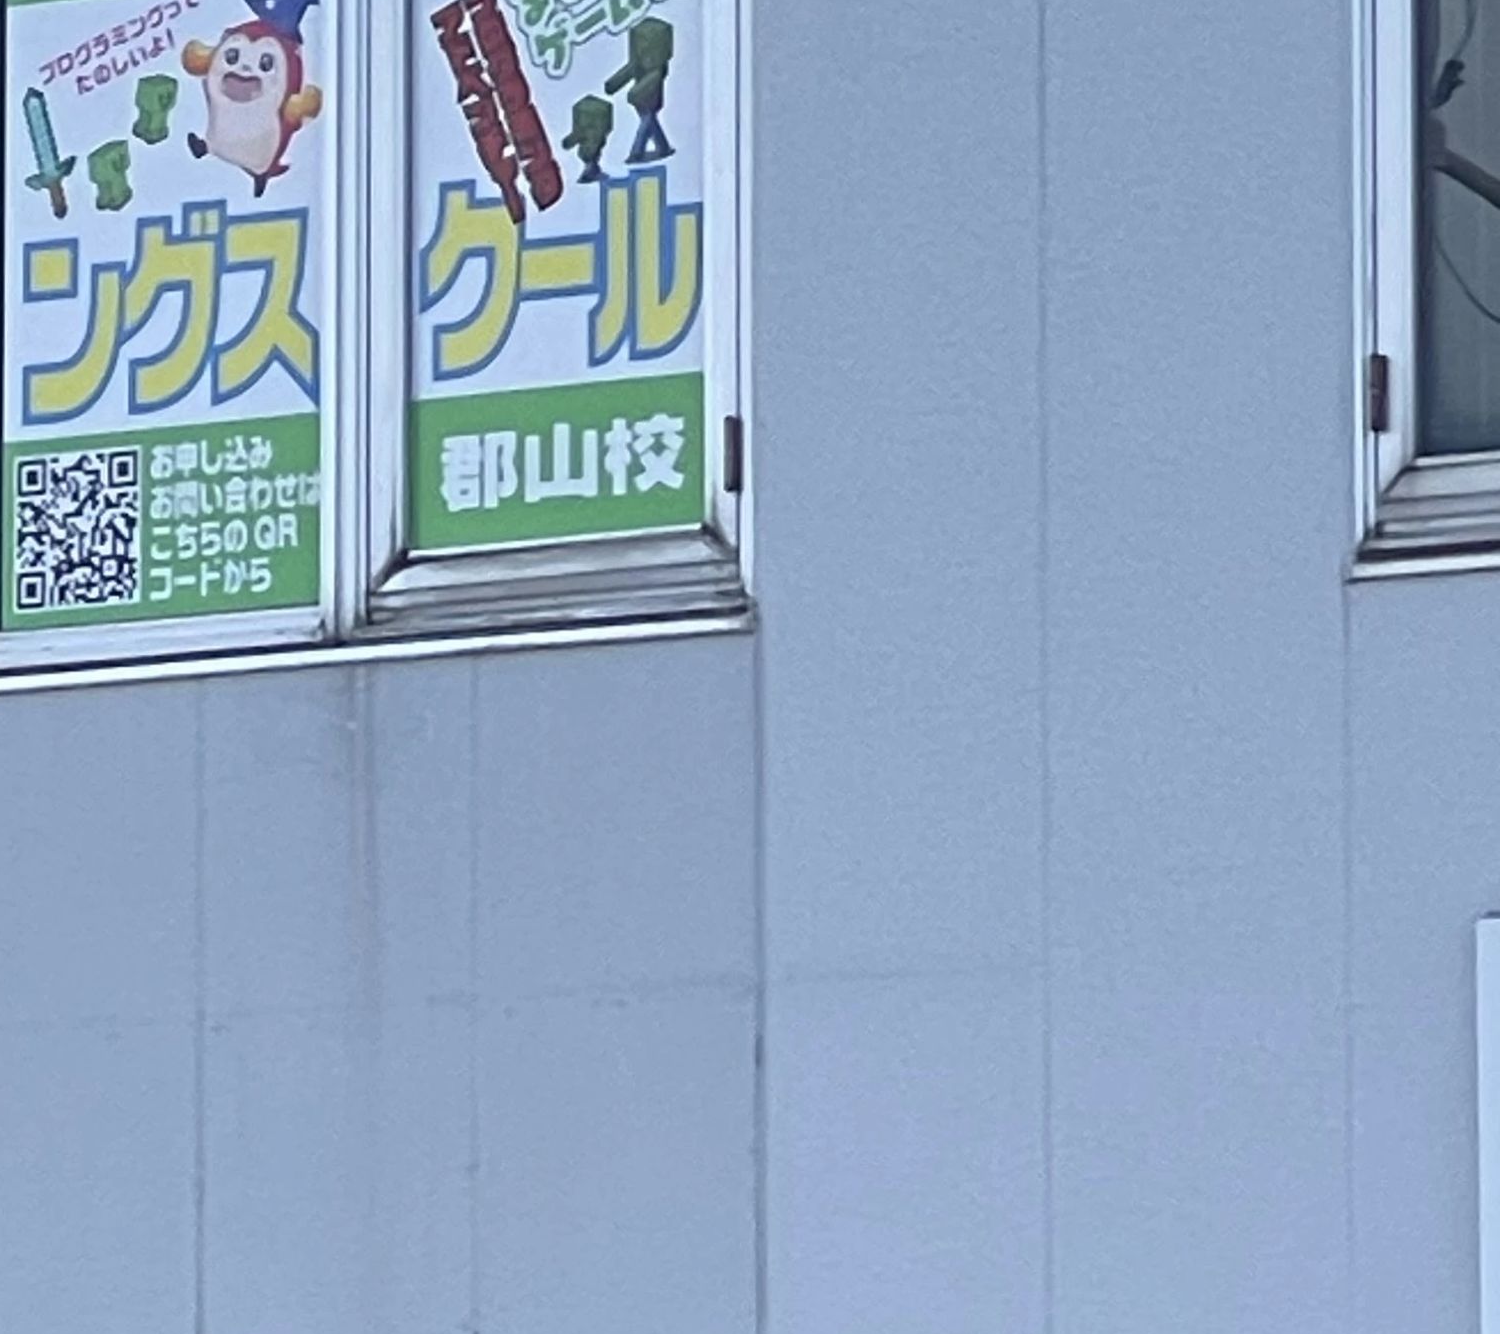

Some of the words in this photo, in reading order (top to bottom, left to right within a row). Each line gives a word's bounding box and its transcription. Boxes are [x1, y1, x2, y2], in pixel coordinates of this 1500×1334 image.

[149, 434, 274, 480] お申し込み
[439, 412, 686, 513] 郡山校
[148, 556, 274, 601] コードから
